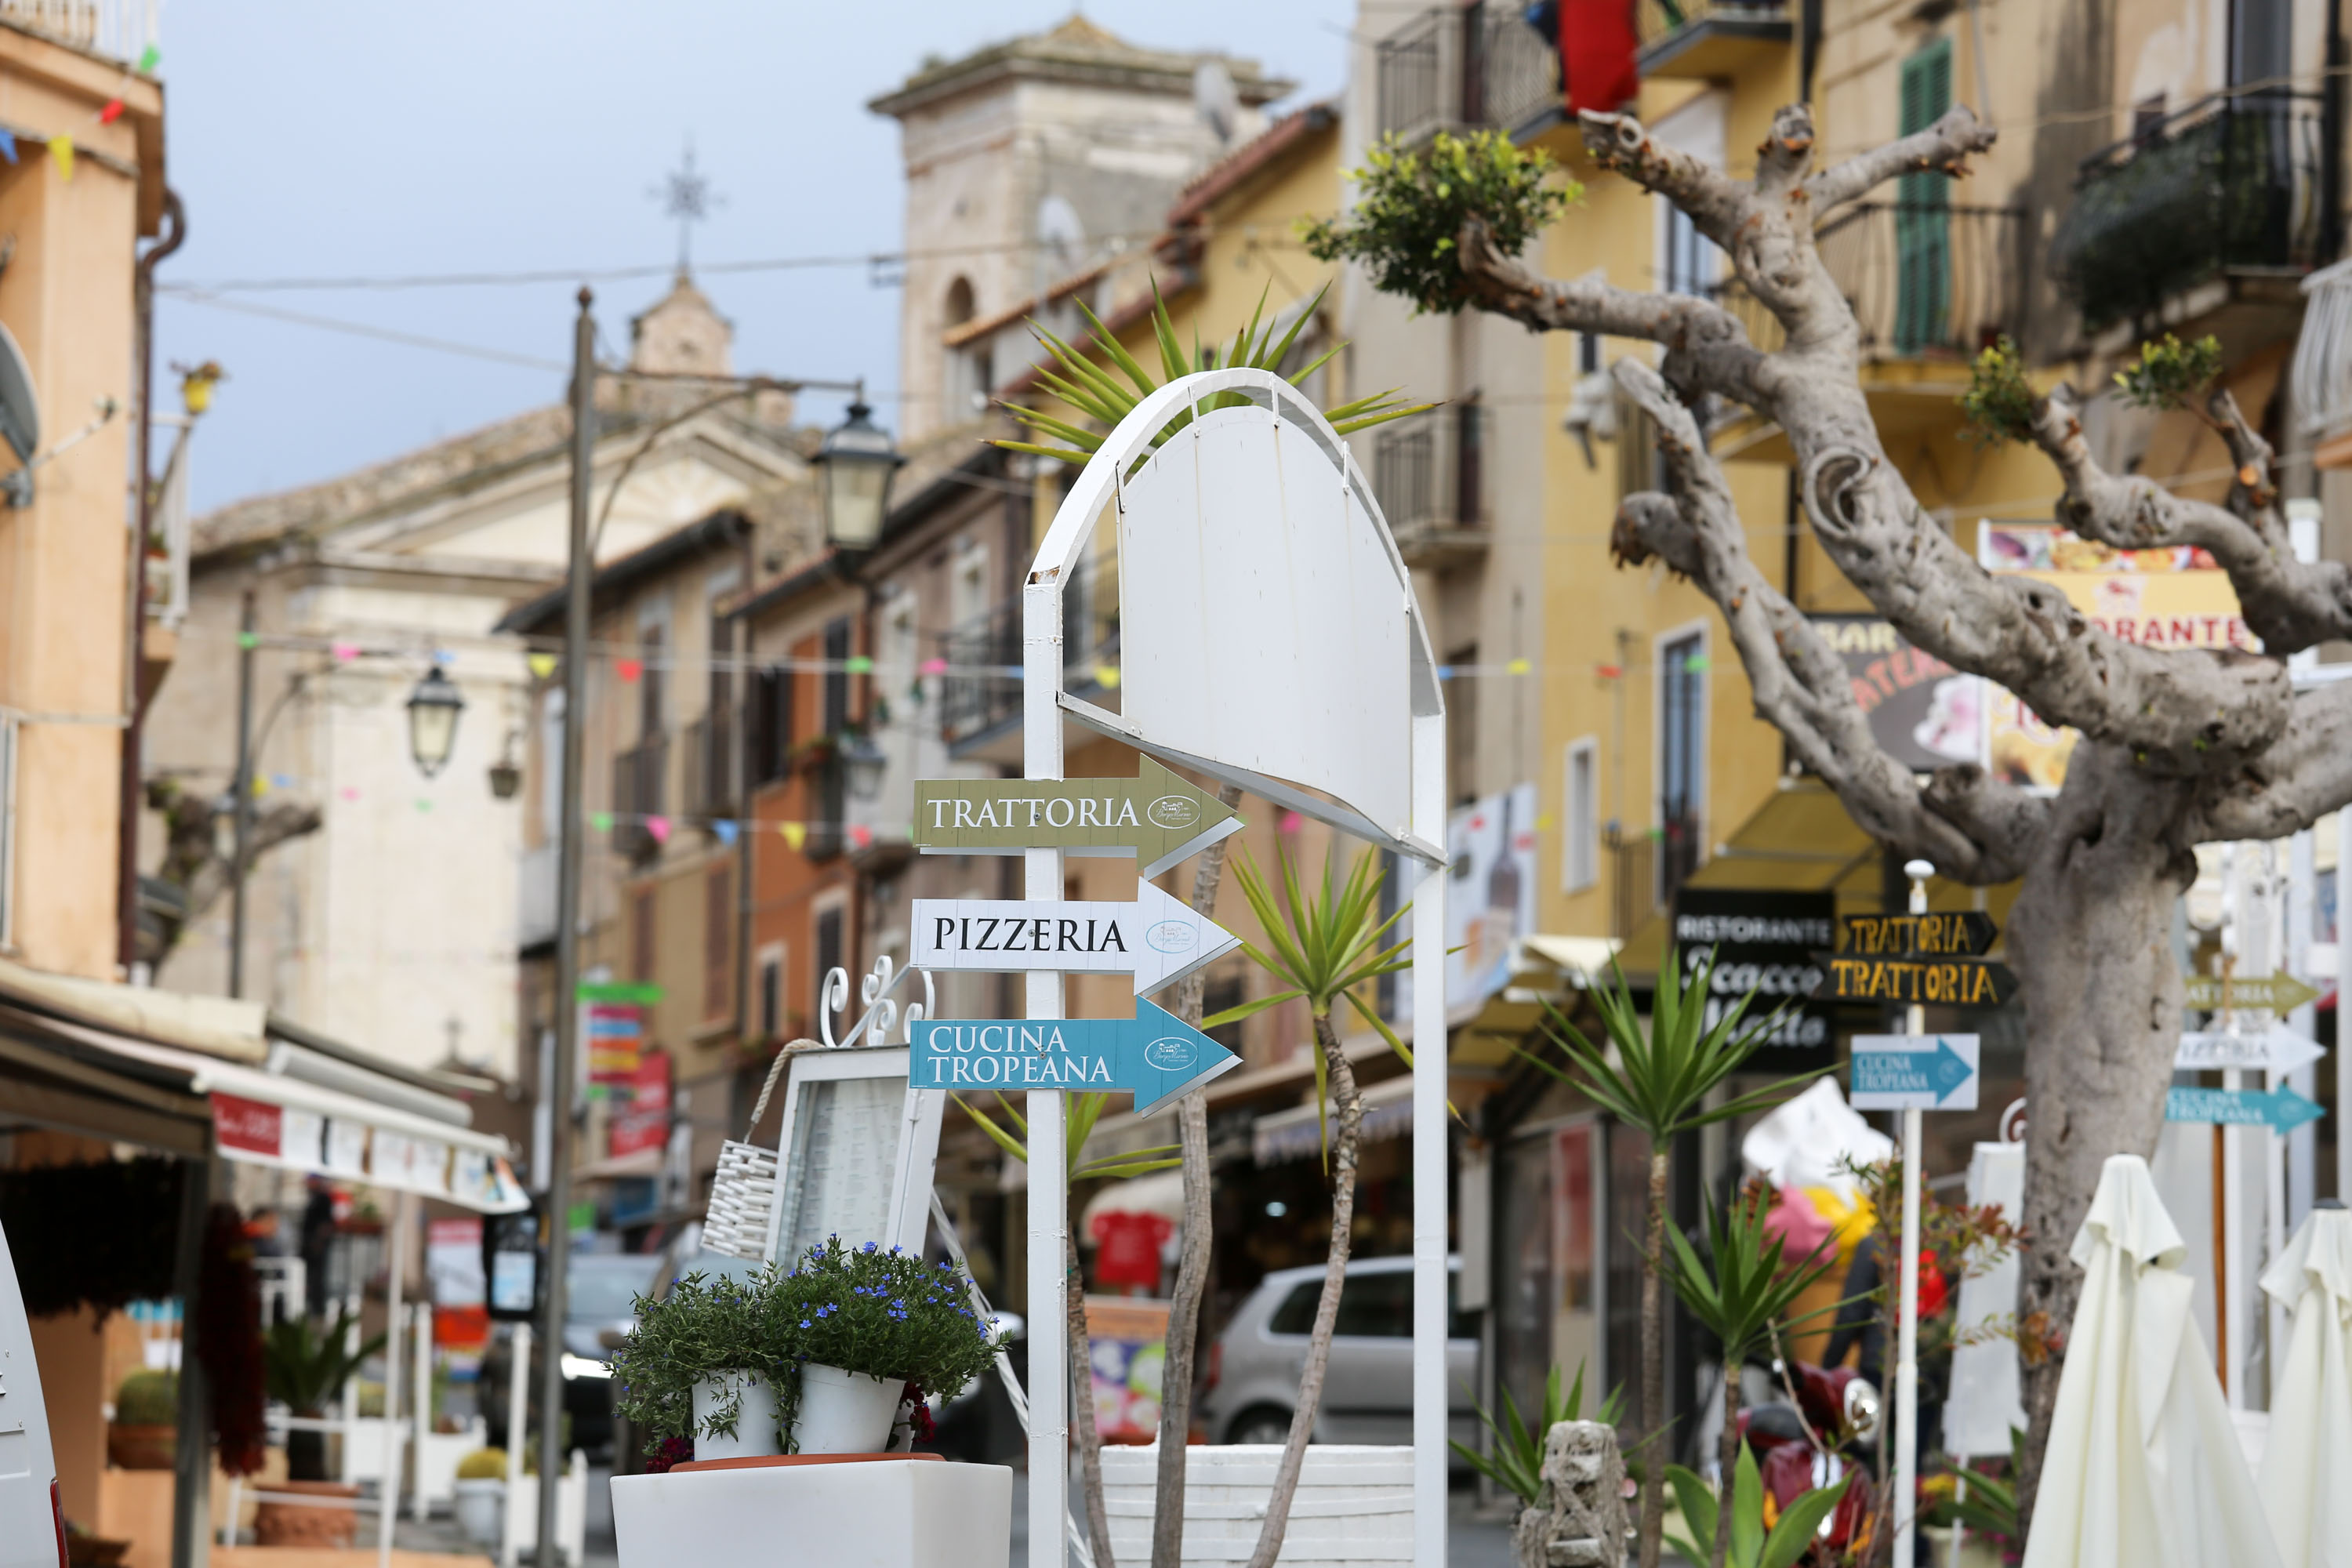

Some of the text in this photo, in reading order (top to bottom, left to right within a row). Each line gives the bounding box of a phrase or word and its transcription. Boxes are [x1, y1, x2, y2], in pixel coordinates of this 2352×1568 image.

[927, 797, 1142, 828] TRATTORIA
[933, 917, 1129, 953] PIZZERIA
[1676, 915, 1832, 943] RISTORANTE
[1849, 915, 1972, 954] TRATTORIA
[1830, 959, 1999, 1004] TRATTORIA
[928, 1025, 1069, 1053] CUCINA
[927, 1055, 1113, 1083] TROPEANA
[1857, 1054, 1912, 1070] CUCINA
[1857, 1070, 1929, 1091] TROPEANA
